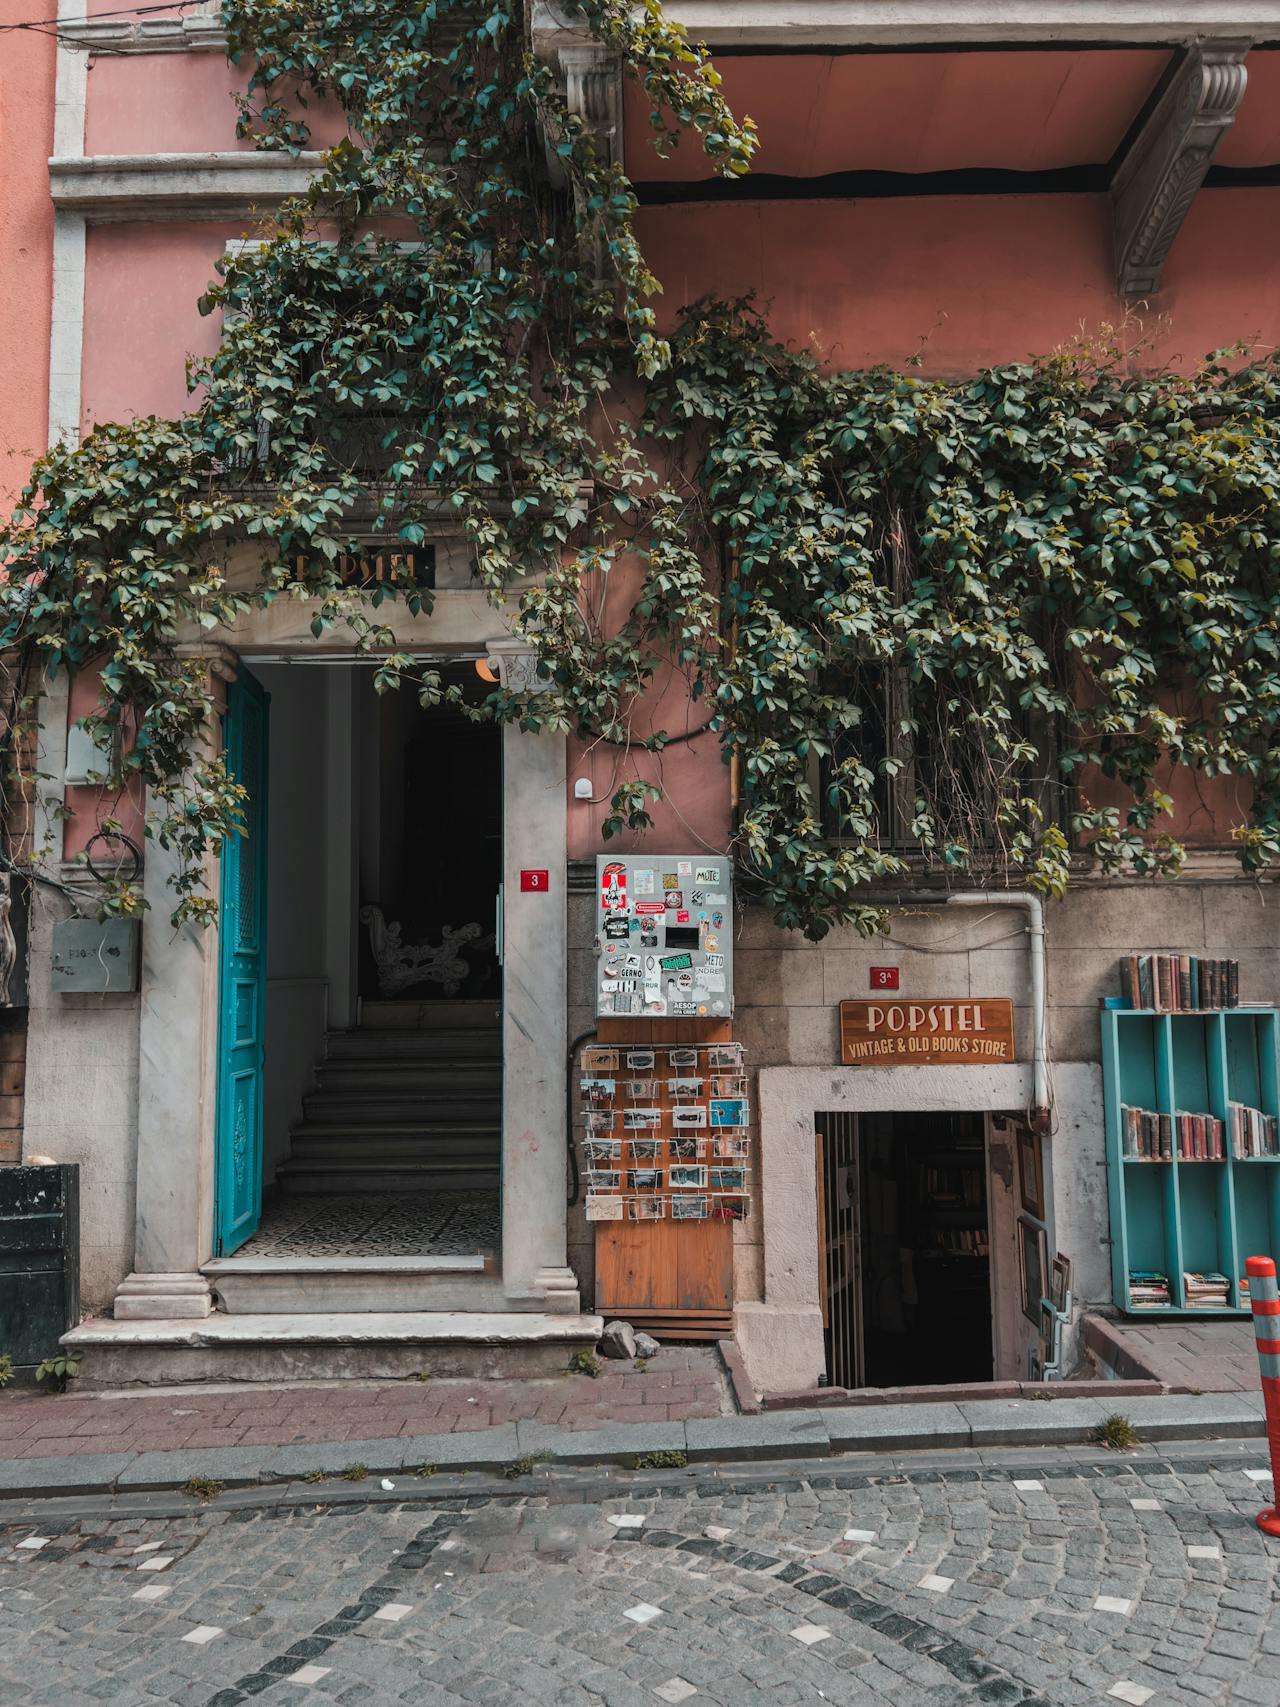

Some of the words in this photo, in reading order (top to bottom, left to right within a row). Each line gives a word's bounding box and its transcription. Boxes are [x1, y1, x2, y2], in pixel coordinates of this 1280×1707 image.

[531, 874, 539, 886] 3
[621, 968, 643, 978] GERNO
[879, 972, 892, 984] 3A
[866, 1005, 987, 1032] POPSTEL
[848, 1038, 895, 1058] VINTAGE
[897, 1037, 906, 1052] &
[908, 1037, 930, 1052] OLD
[932, 1037, 969, 1053] BOOKS
[971, 1038, 1007, 1057] STORE
